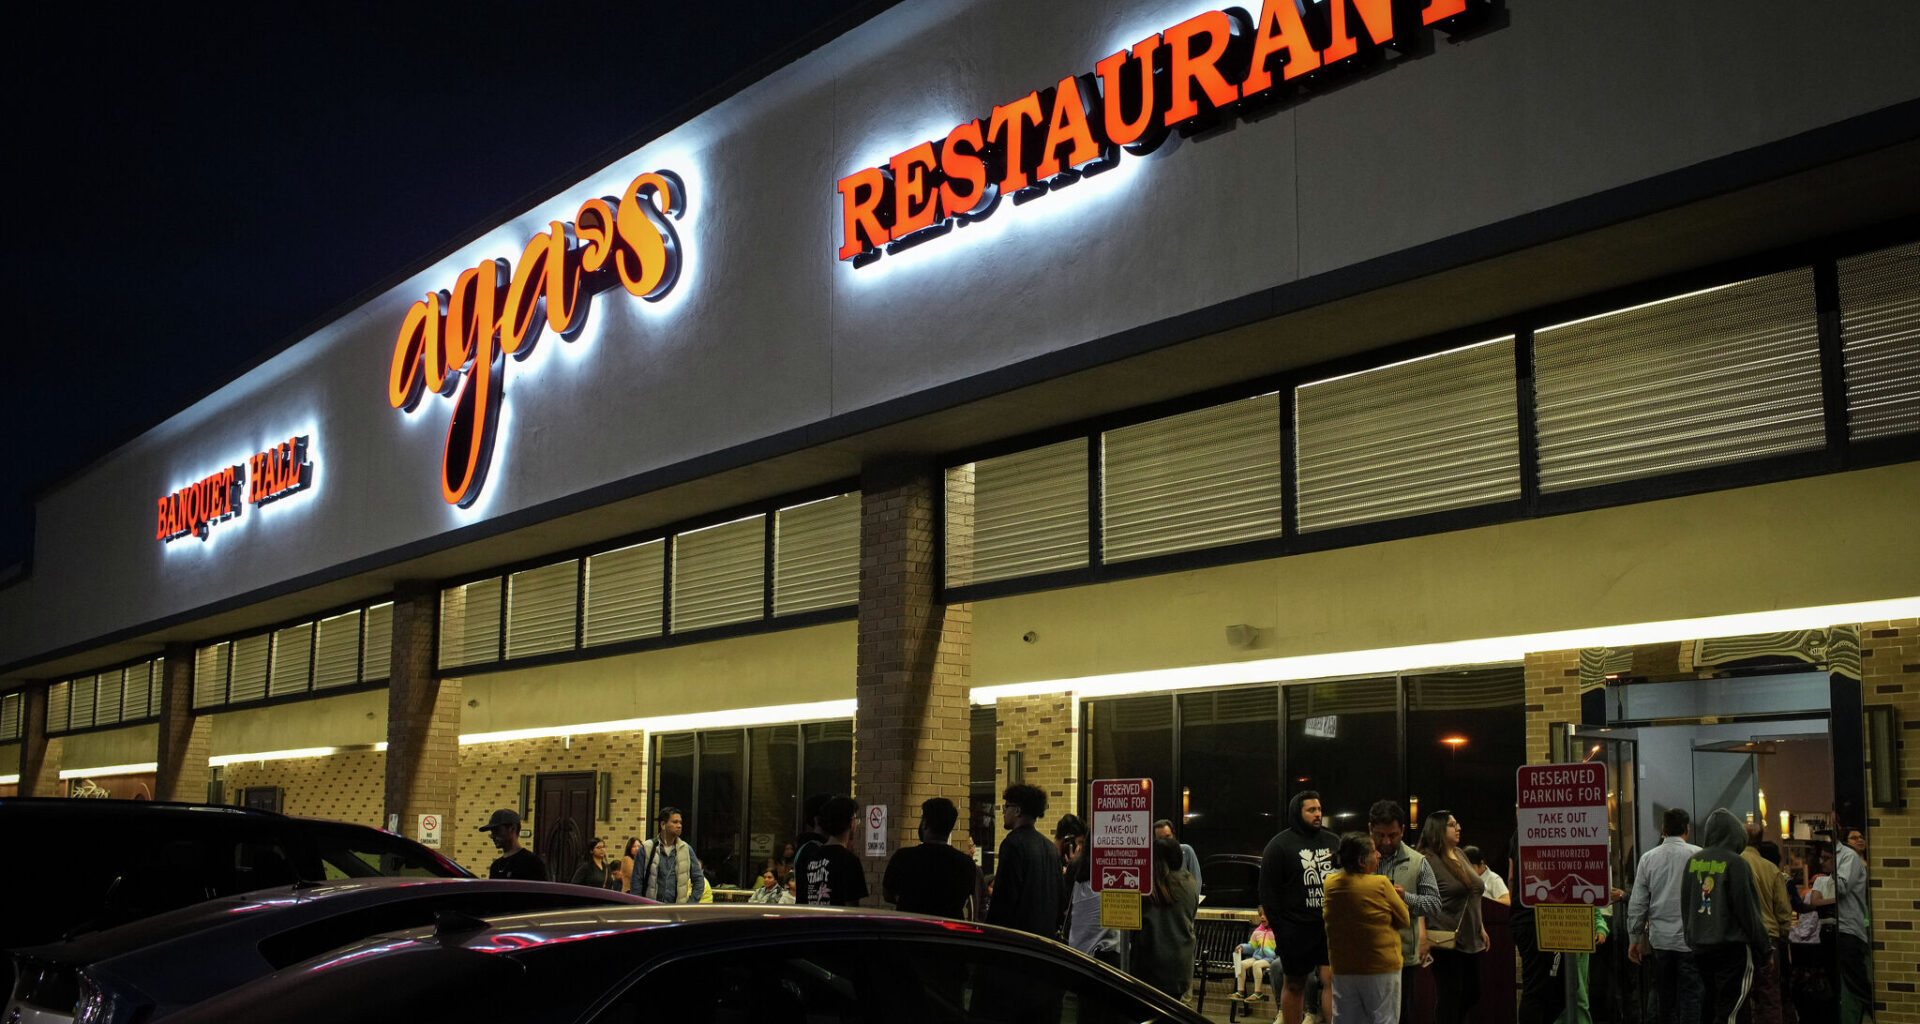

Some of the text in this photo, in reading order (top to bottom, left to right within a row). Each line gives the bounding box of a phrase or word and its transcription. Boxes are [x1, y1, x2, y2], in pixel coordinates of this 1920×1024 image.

[837, 0, 1468, 261] RESTAURAN
[156, 437, 301, 540] BANQUET HALL
[1530, 769, 1595, 786] RESERVED
[1103, 783, 1140, 796] RESERVED
[1523, 787, 1601, 803] PARKING FOR
[1097, 796, 1147, 809] PARKING FOR
[1111, 813, 1132, 823] AGA'S
[1537, 812, 1587, 824] TAKE OUT
[1104, 825, 1138, 834] TAKE-OUT
[1527, 826, 1599, 839] ORDERS ONLY
[1096, 836, 1146, 846] ORDERS ONLY
[1536, 849, 1590, 858] UNAUTHORIZED
[1523, 861, 1604, 870] VEHICLES TOWED AWAY
[1308, 887, 1325, 897] HAV
